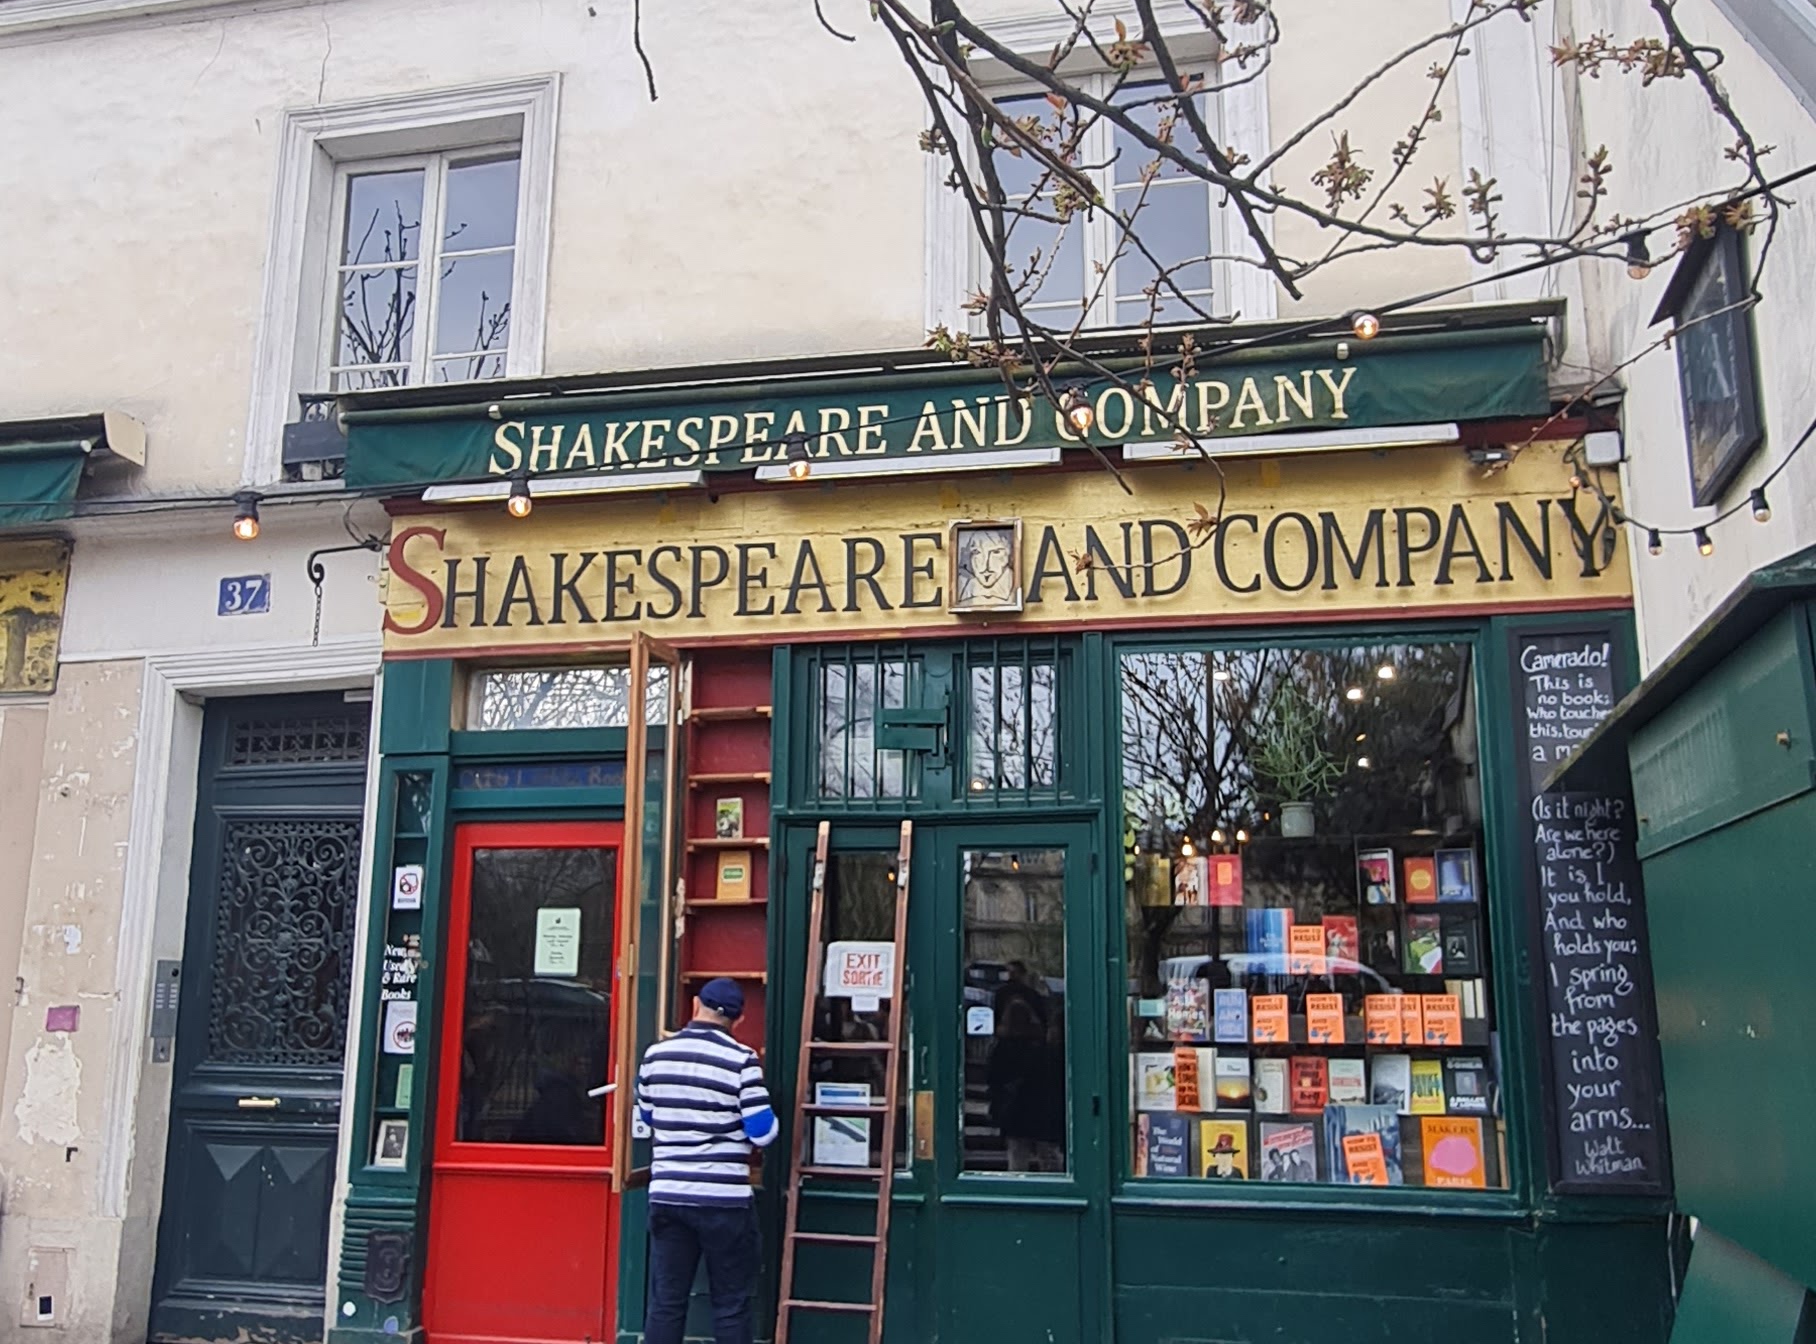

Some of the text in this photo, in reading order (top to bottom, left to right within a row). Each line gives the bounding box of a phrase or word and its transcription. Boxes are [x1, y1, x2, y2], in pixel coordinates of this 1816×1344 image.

[488, 366, 1358, 475] SHAKESPEARE AND COMPANY
[383, 495, 1618, 636] SHAKESPEARE AND COMPANY
[225, 579, 262, 612] 37
[1520, 643, 1610, 673] Camerado!
[1529, 673, 1594, 692] This is
[1537, 694, 1557, 706] no
[1532, 745, 1547, 762] a
[1556, 796, 1570, 820] it
[1534, 823, 1621, 843] Are we here
[1541, 865, 1556, 887] It
[1568, 865, 1587, 884] is
[1548, 883, 1632, 910] you hold,
[1544, 909, 1627, 931] And who
[1554, 932, 1600, 956] holds
[846, 953, 880, 969] EXIT
[842, 969, 884, 986] SORTIE
[1550, 962, 1634, 996] I spring
[381, 987, 412, 1000] Books
[1564, 985, 1615, 1015] from
[1551, 1015, 1638, 1047] the pages
[1570, 1049, 1619, 1073] into
[1567, 1080, 1622, 1110] your
[1584, 1136, 1625, 1158] Walt
[1576, 1155, 1646, 1176] Whitman
